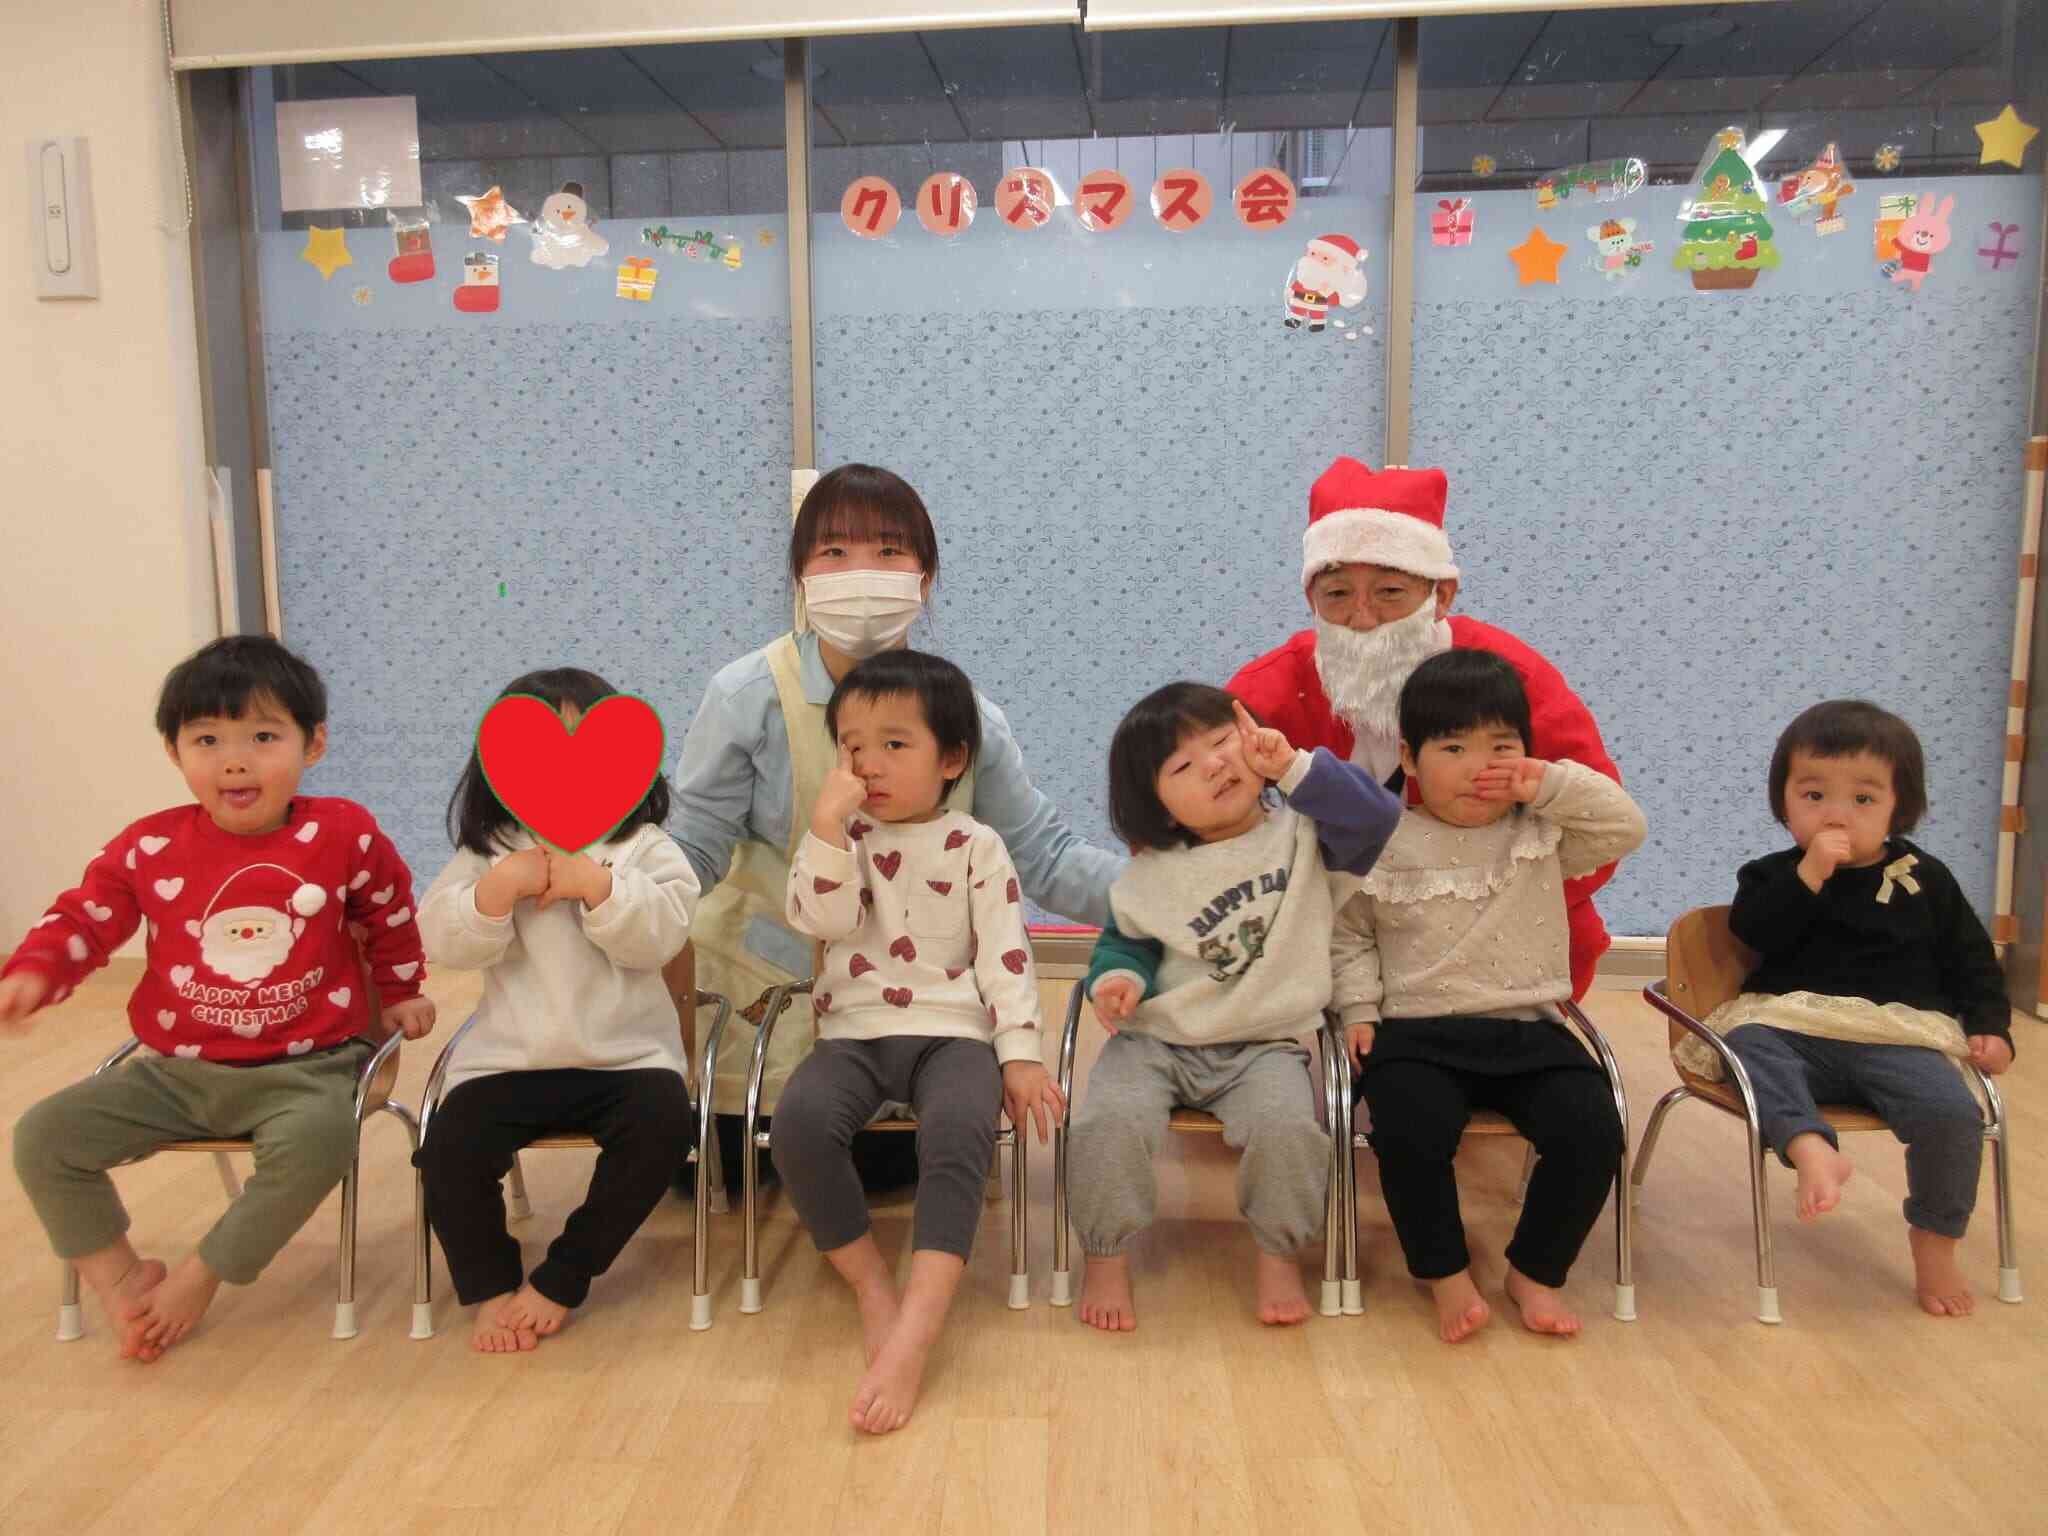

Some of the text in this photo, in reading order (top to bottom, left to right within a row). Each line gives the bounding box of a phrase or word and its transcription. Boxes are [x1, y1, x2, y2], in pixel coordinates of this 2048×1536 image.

[852, 173, 1289, 230] クリスマス会
[1187, 880, 1255, 937] HAPPY
[179, 966, 324, 1005] HAPPY MERRY
[191, 996, 308, 1026] CHRISTMAS
